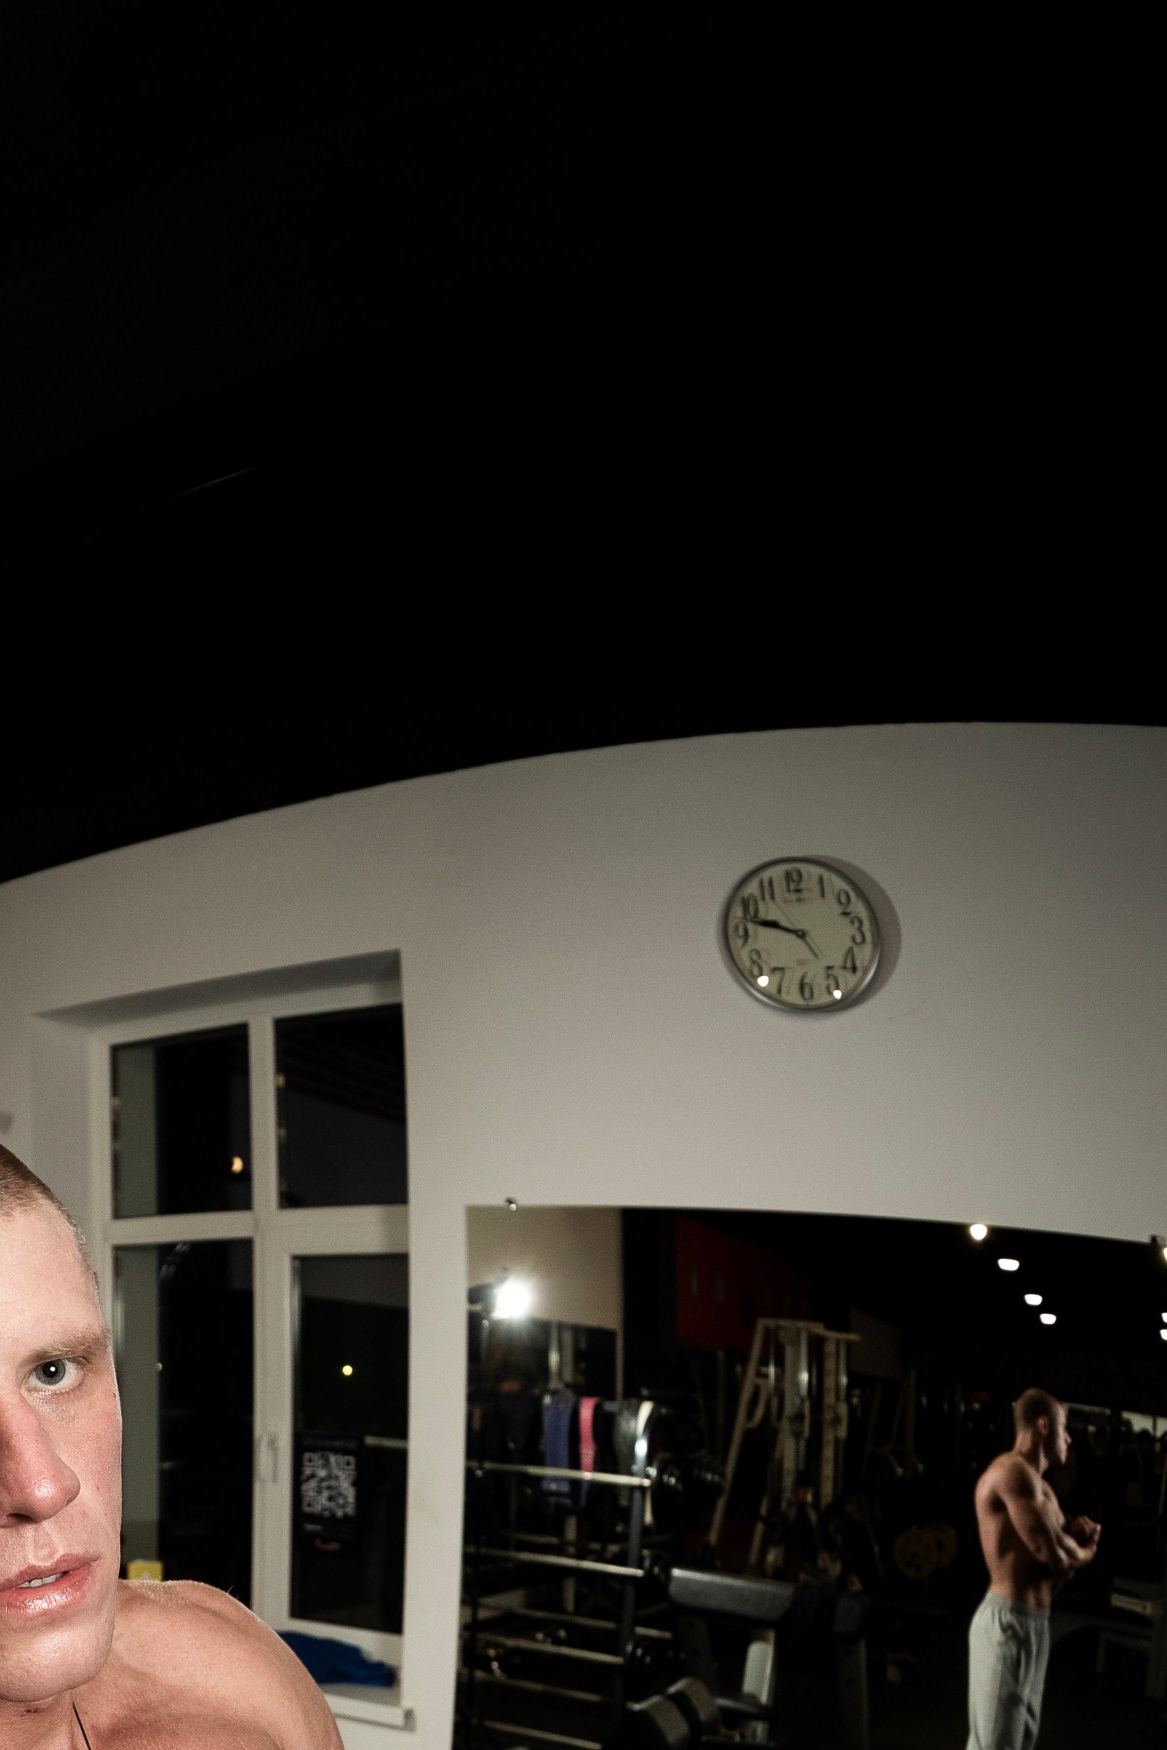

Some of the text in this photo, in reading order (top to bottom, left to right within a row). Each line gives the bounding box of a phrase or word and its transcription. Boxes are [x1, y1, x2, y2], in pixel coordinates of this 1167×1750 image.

[759, 875, 775, 902] 11
[785, 866, 803, 893] 12
[818, 873, 826, 898] 1
[741, 892, 759, 920] 10
[837, 888, 852, 916] 2
[737, 921, 749, 947] 9
[850, 915, 866, 946] 3
[749, 948, 764, 978] 8
[841, 946, 858, 975] 4
[770, 966, 786, 996] 7
[799, 970, 814, 1002] 6
[825, 965, 840, 997] 5
